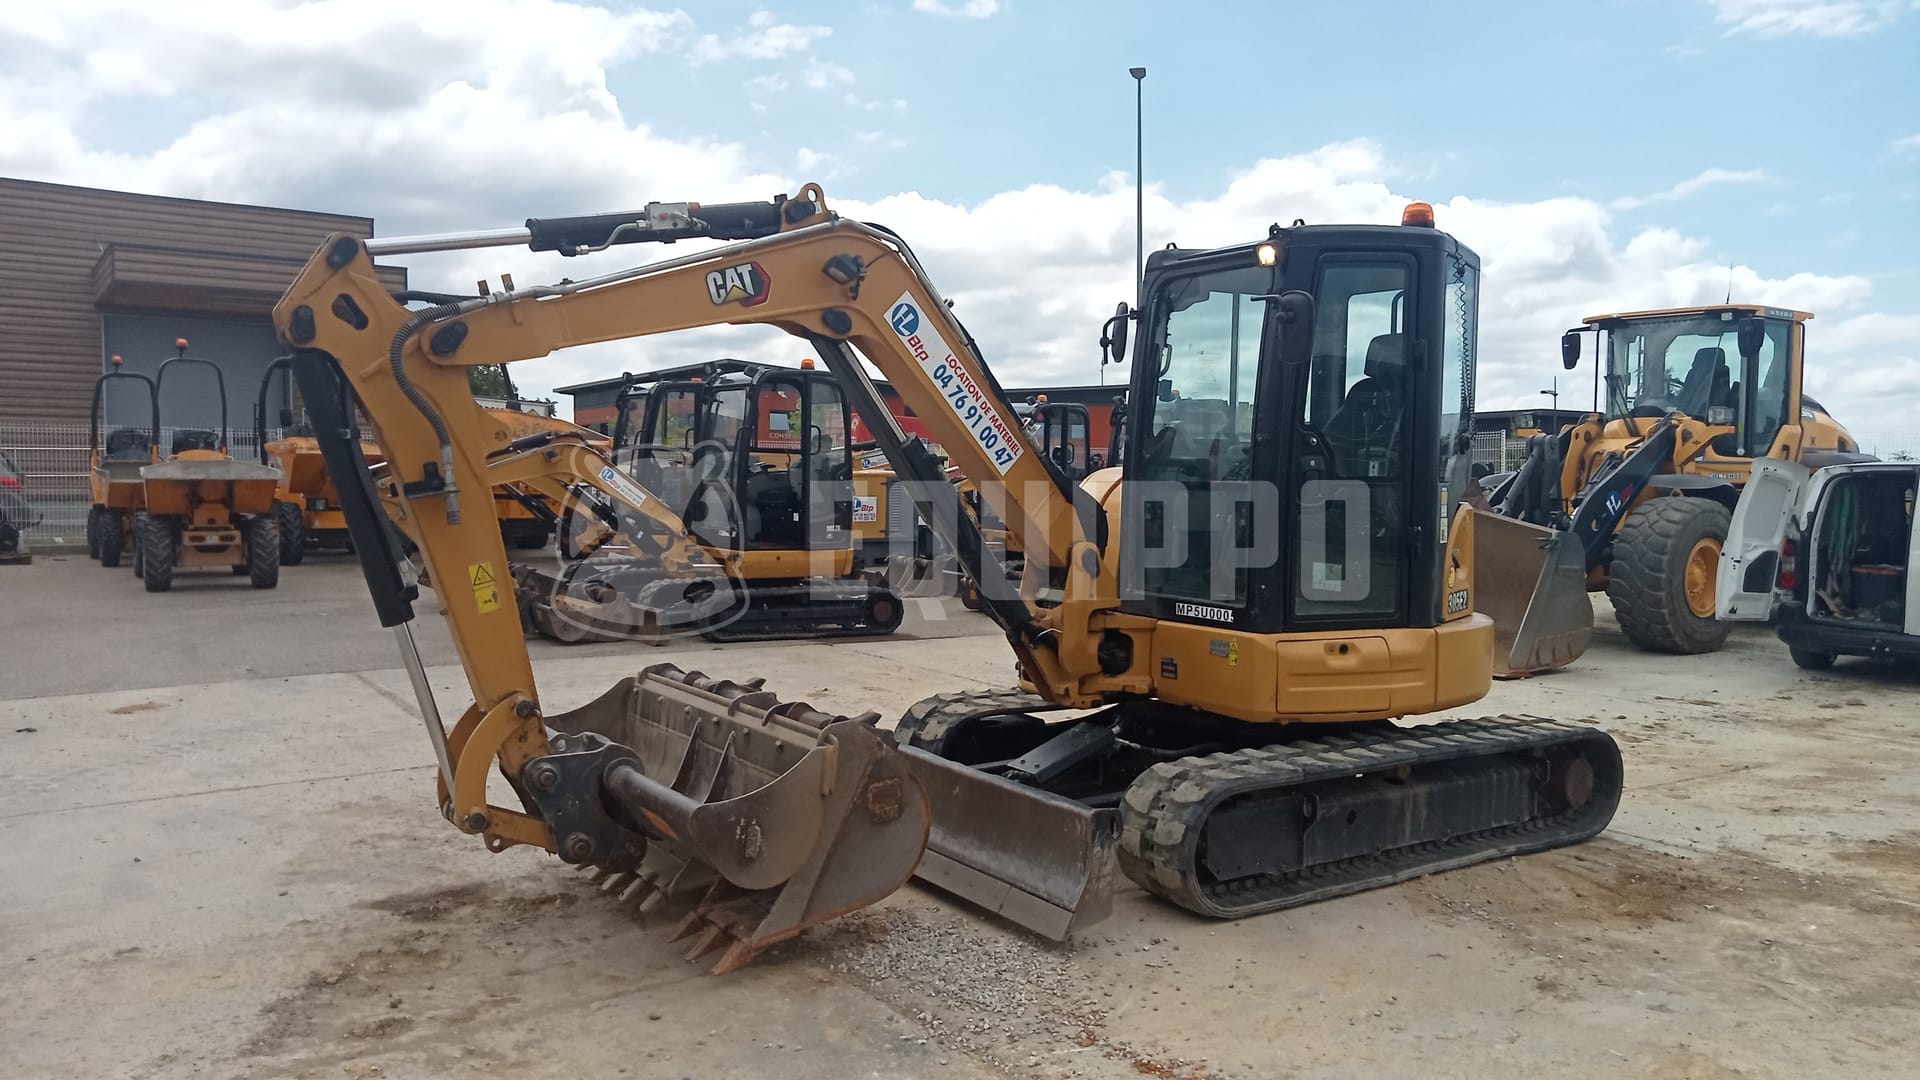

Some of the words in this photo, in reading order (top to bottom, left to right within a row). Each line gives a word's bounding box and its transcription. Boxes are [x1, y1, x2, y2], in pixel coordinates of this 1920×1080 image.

[706, 264, 755, 305] CAT
[907, 334, 928, 362] Btp
[933, 364, 954, 390] 04
[948, 386, 968, 410] 76
[965, 405, 983, 429] 91
[979, 426, 998, 450] 00
[995, 447, 1014, 467] 47
[945, 353, 980, 402] LOCATION
[979, 401, 992, 416] DE
[989, 414, 1020, 456] MATERIEL
[1448, 590, 1467, 613] 305E2
